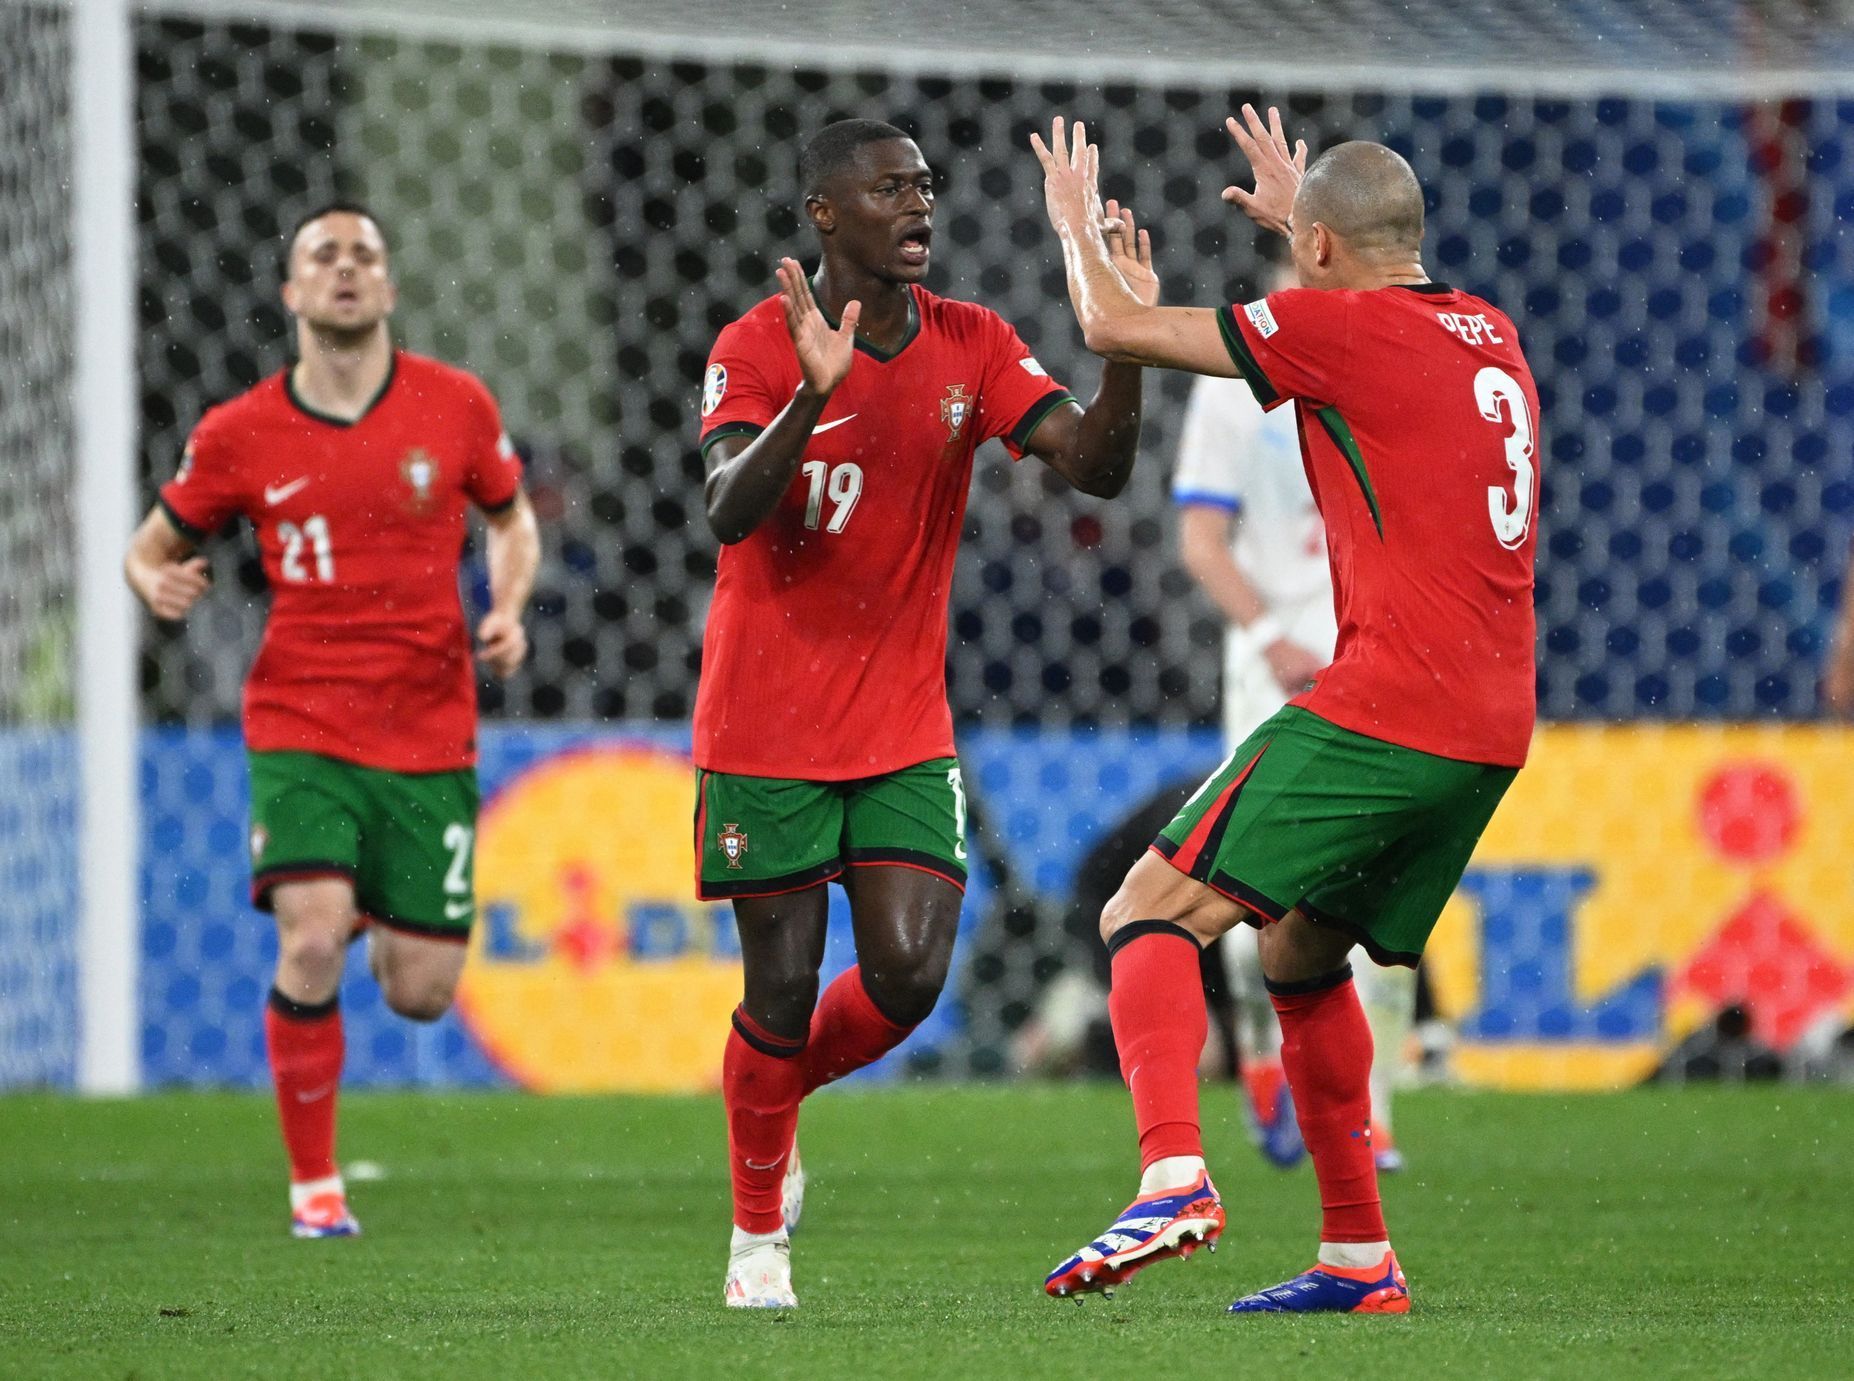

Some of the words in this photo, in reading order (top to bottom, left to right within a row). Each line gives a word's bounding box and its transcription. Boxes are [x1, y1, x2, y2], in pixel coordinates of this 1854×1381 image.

[1436, 312, 1504, 346] PEPE
[1473, 366, 1534, 551] 3
[802, 460, 864, 534] 19
[276, 515, 334, 584] 21
